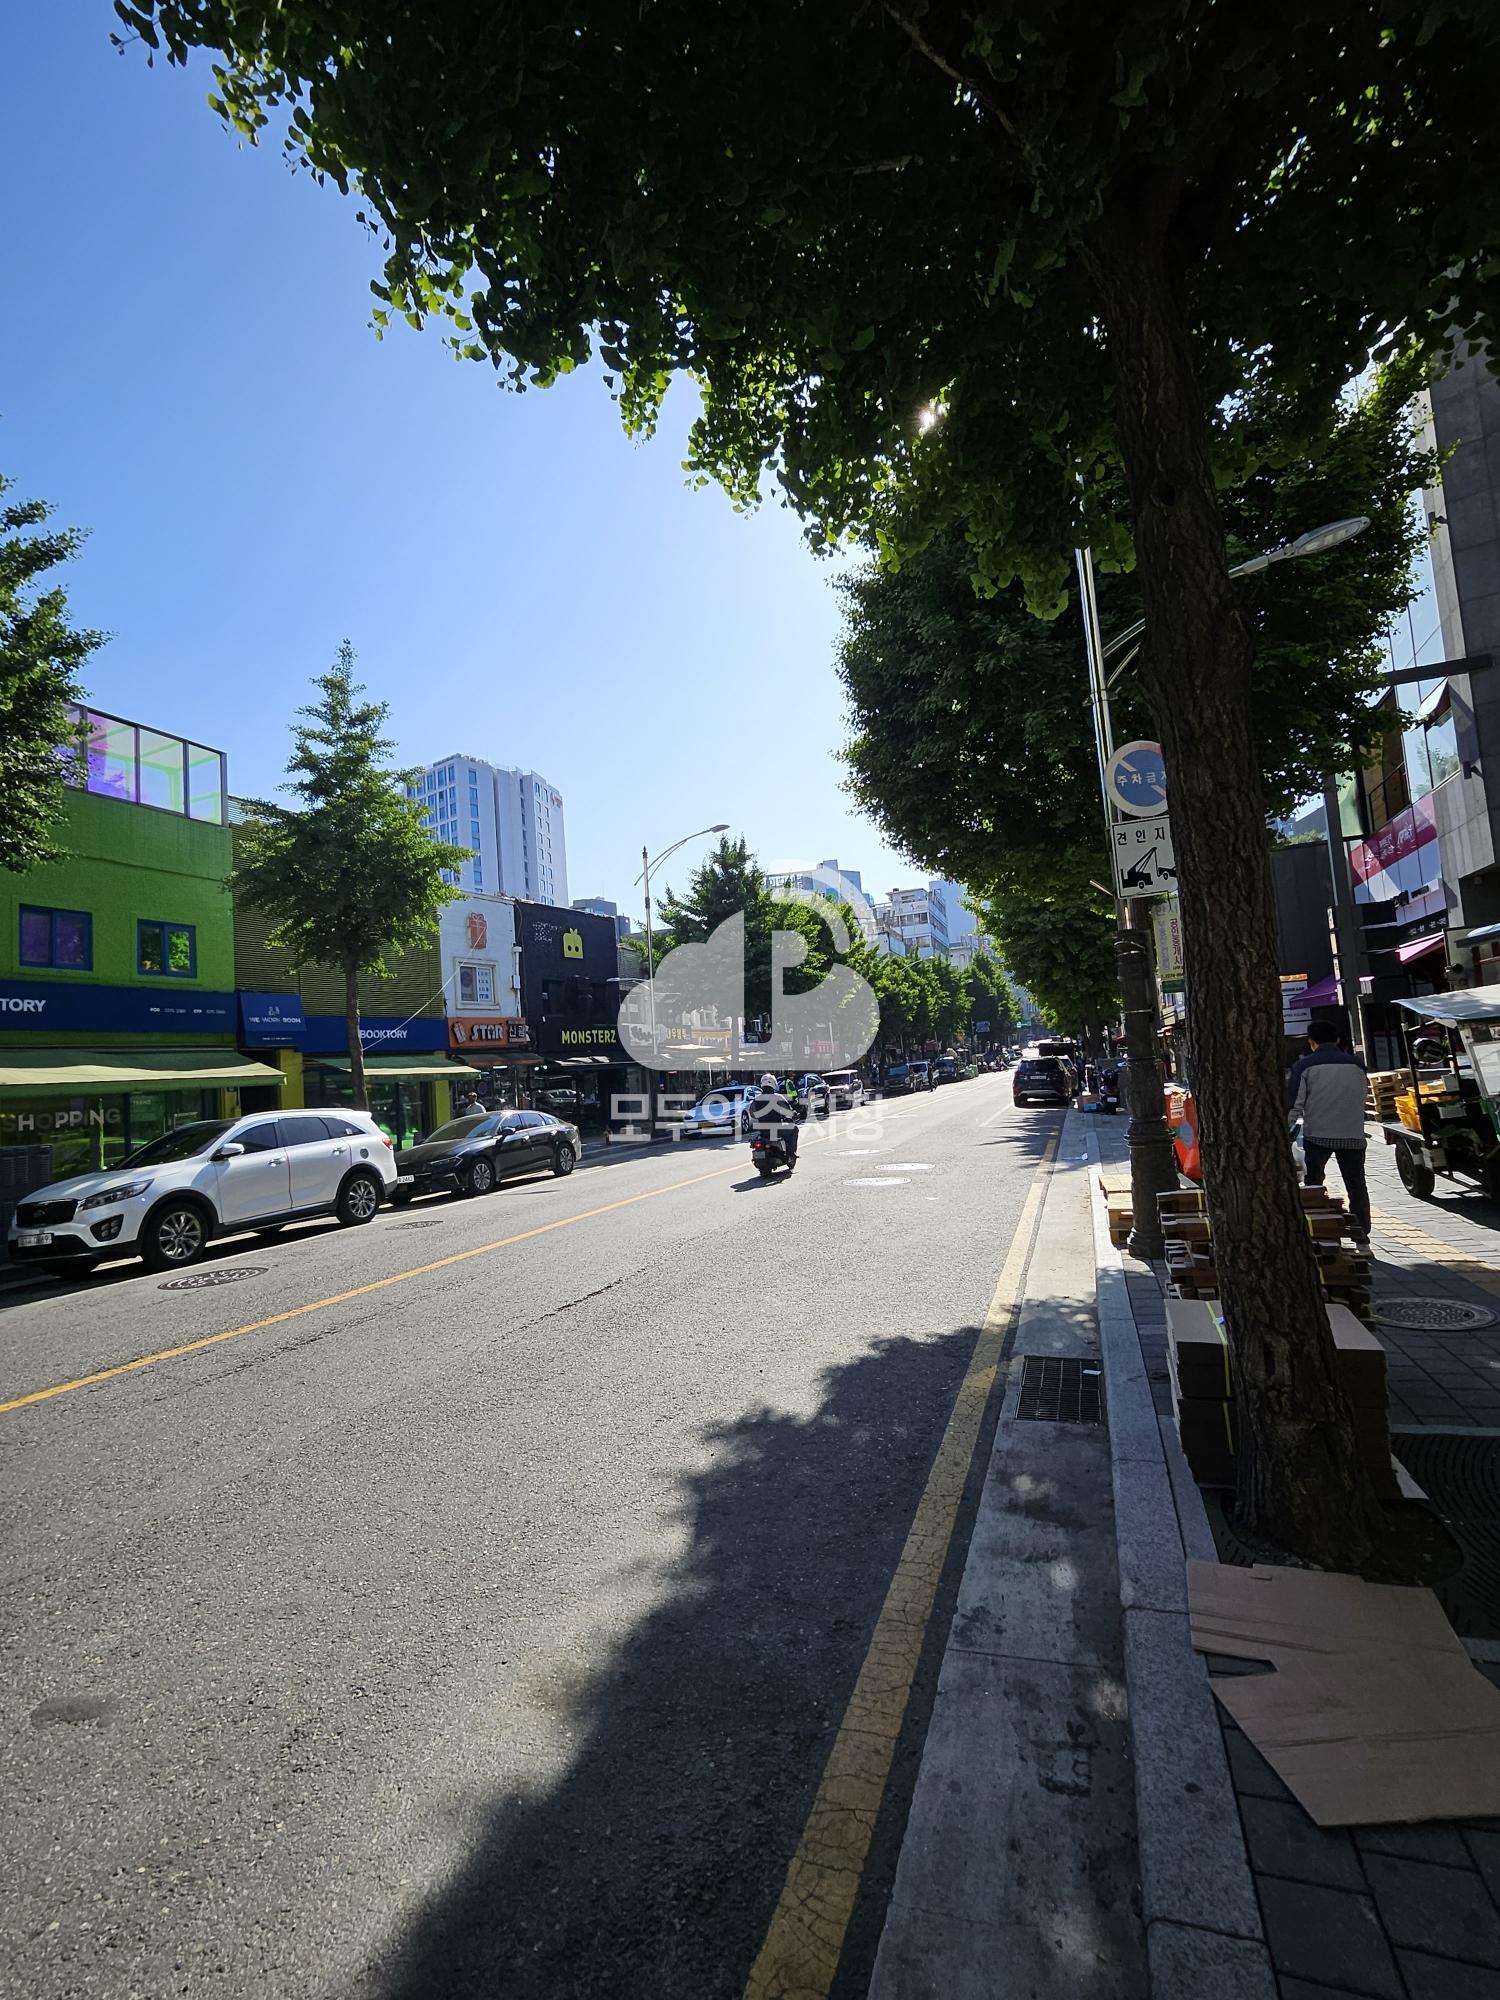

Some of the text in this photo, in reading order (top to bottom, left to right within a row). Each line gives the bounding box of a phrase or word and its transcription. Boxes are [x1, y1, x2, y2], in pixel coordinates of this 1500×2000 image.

[0, 998, 46, 1012] TORY
[360, 1030, 408, 1039] BOOKTORY
[562, 1030, 616, 1045] MONSTERZ
